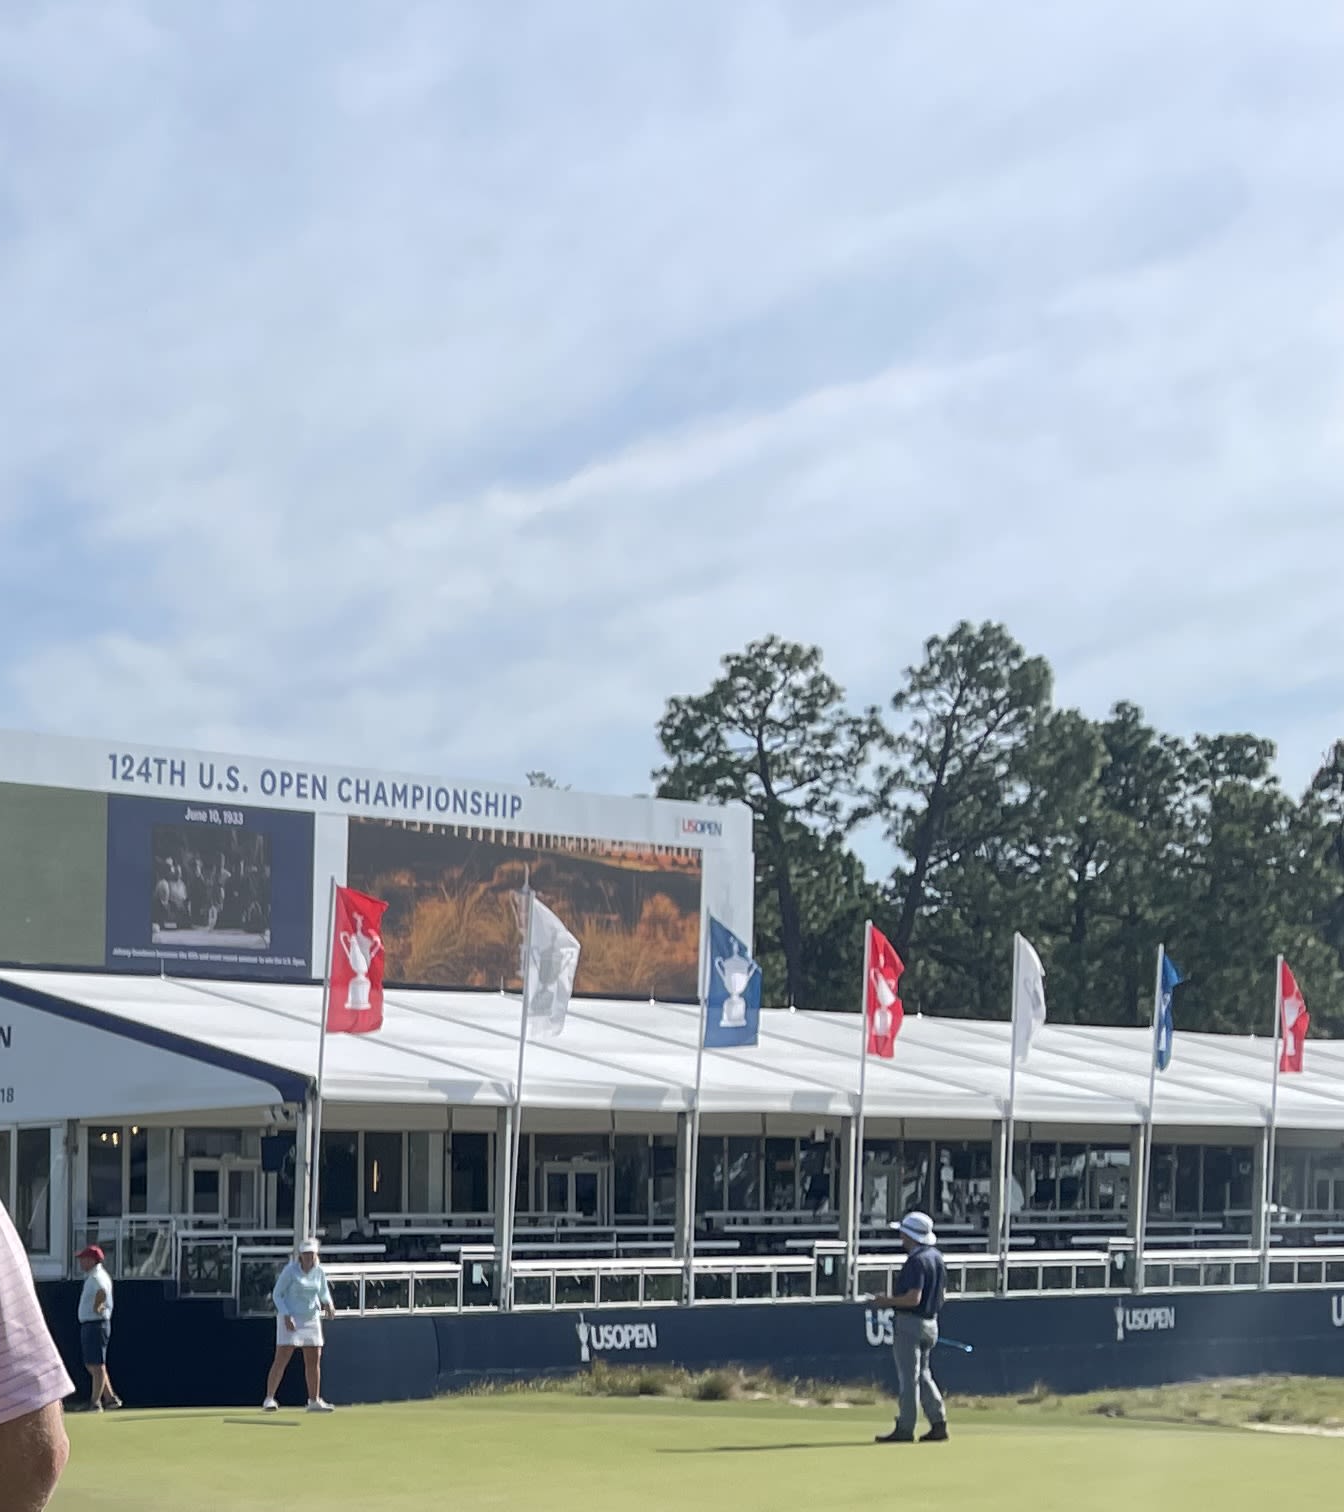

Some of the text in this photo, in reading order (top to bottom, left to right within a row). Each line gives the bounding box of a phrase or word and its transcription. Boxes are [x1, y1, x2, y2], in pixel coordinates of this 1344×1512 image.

[109, 754, 522, 819] 124TH U.S. OPEN CHAMPIONSHIP
[0, 1088, 14, 1103] 18
[591, 1323, 657, 1350] USOPEN
